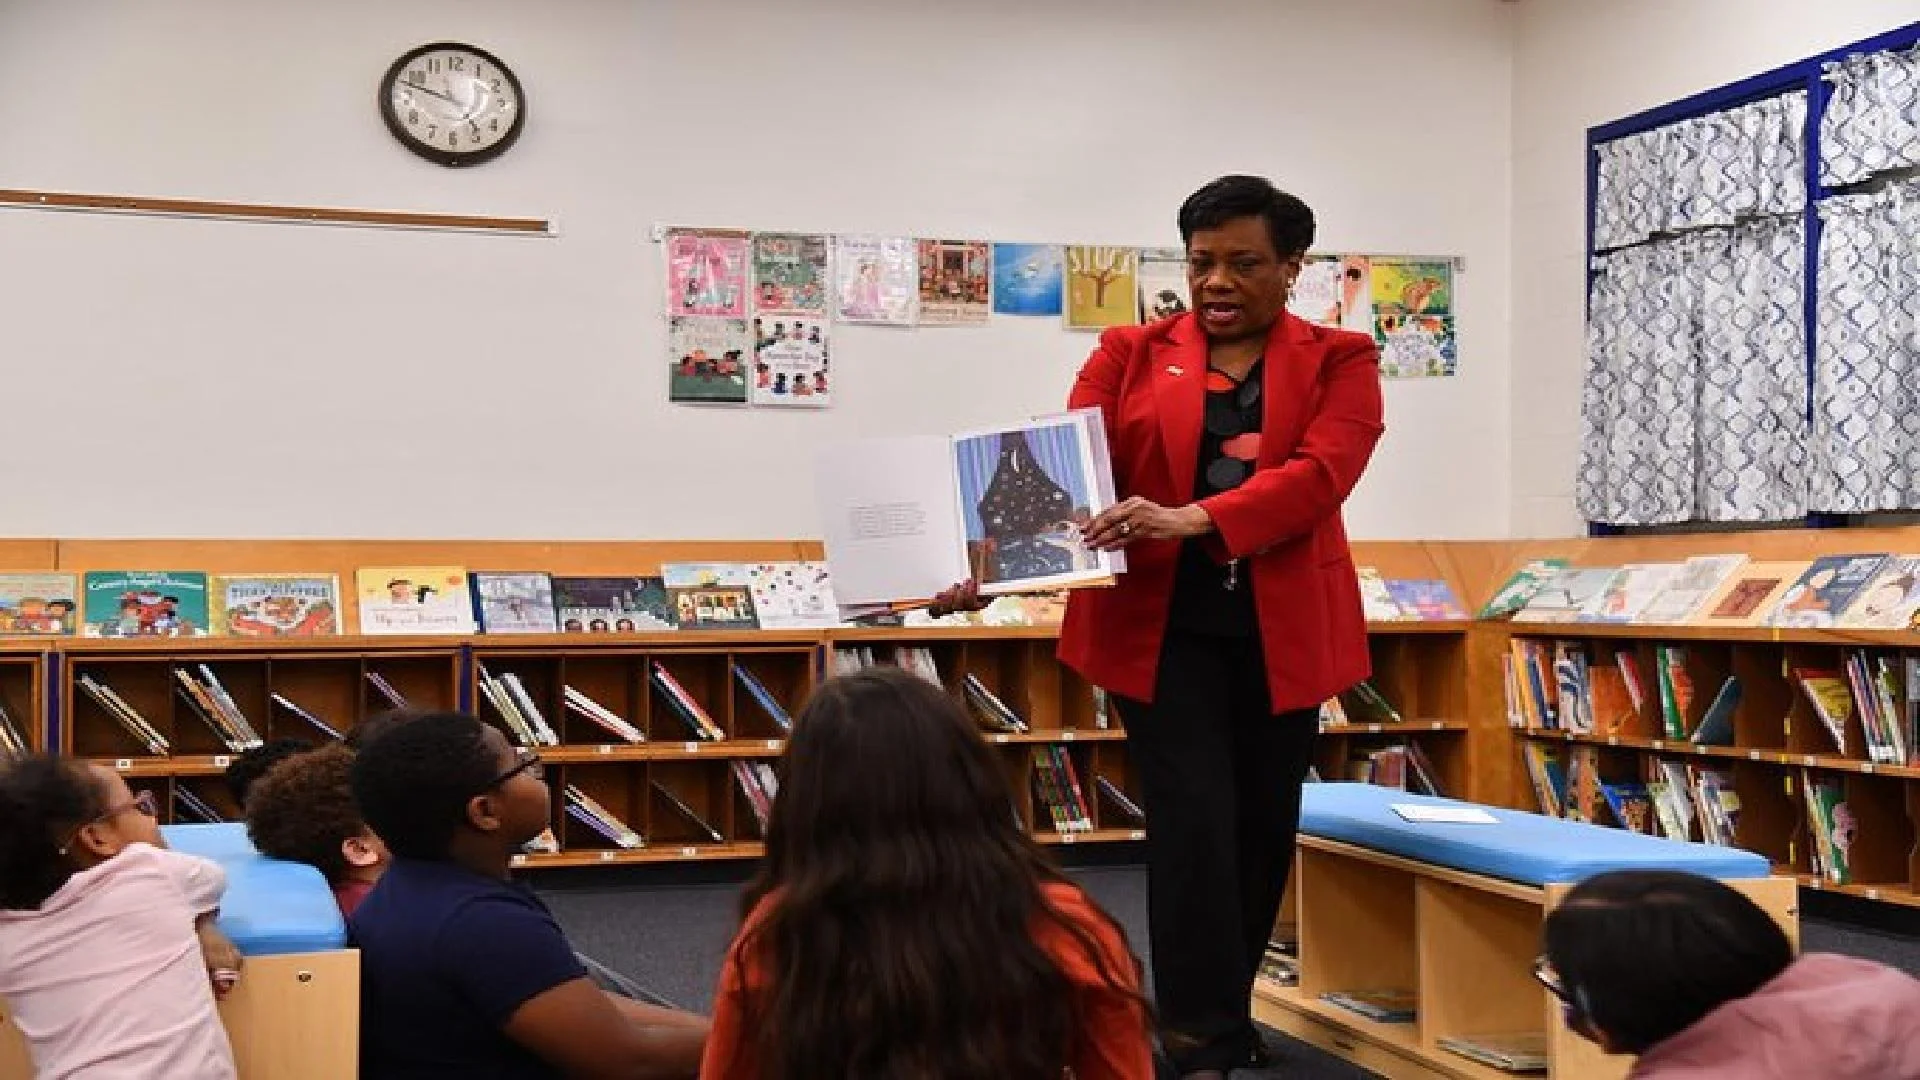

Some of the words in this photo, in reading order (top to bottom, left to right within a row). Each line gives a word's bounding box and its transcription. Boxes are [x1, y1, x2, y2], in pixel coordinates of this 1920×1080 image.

[427, 58, 441, 74] 11
[448, 56, 463, 71] 12
[408, 70, 426, 84] 10
[476, 64, 481, 78] 1
[491, 79, 501, 93] 2
[408, 109, 418, 124] 8
[426, 124, 438, 138] 7
[488, 118, 498, 132] 4
[448, 130, 458, 145] 6
